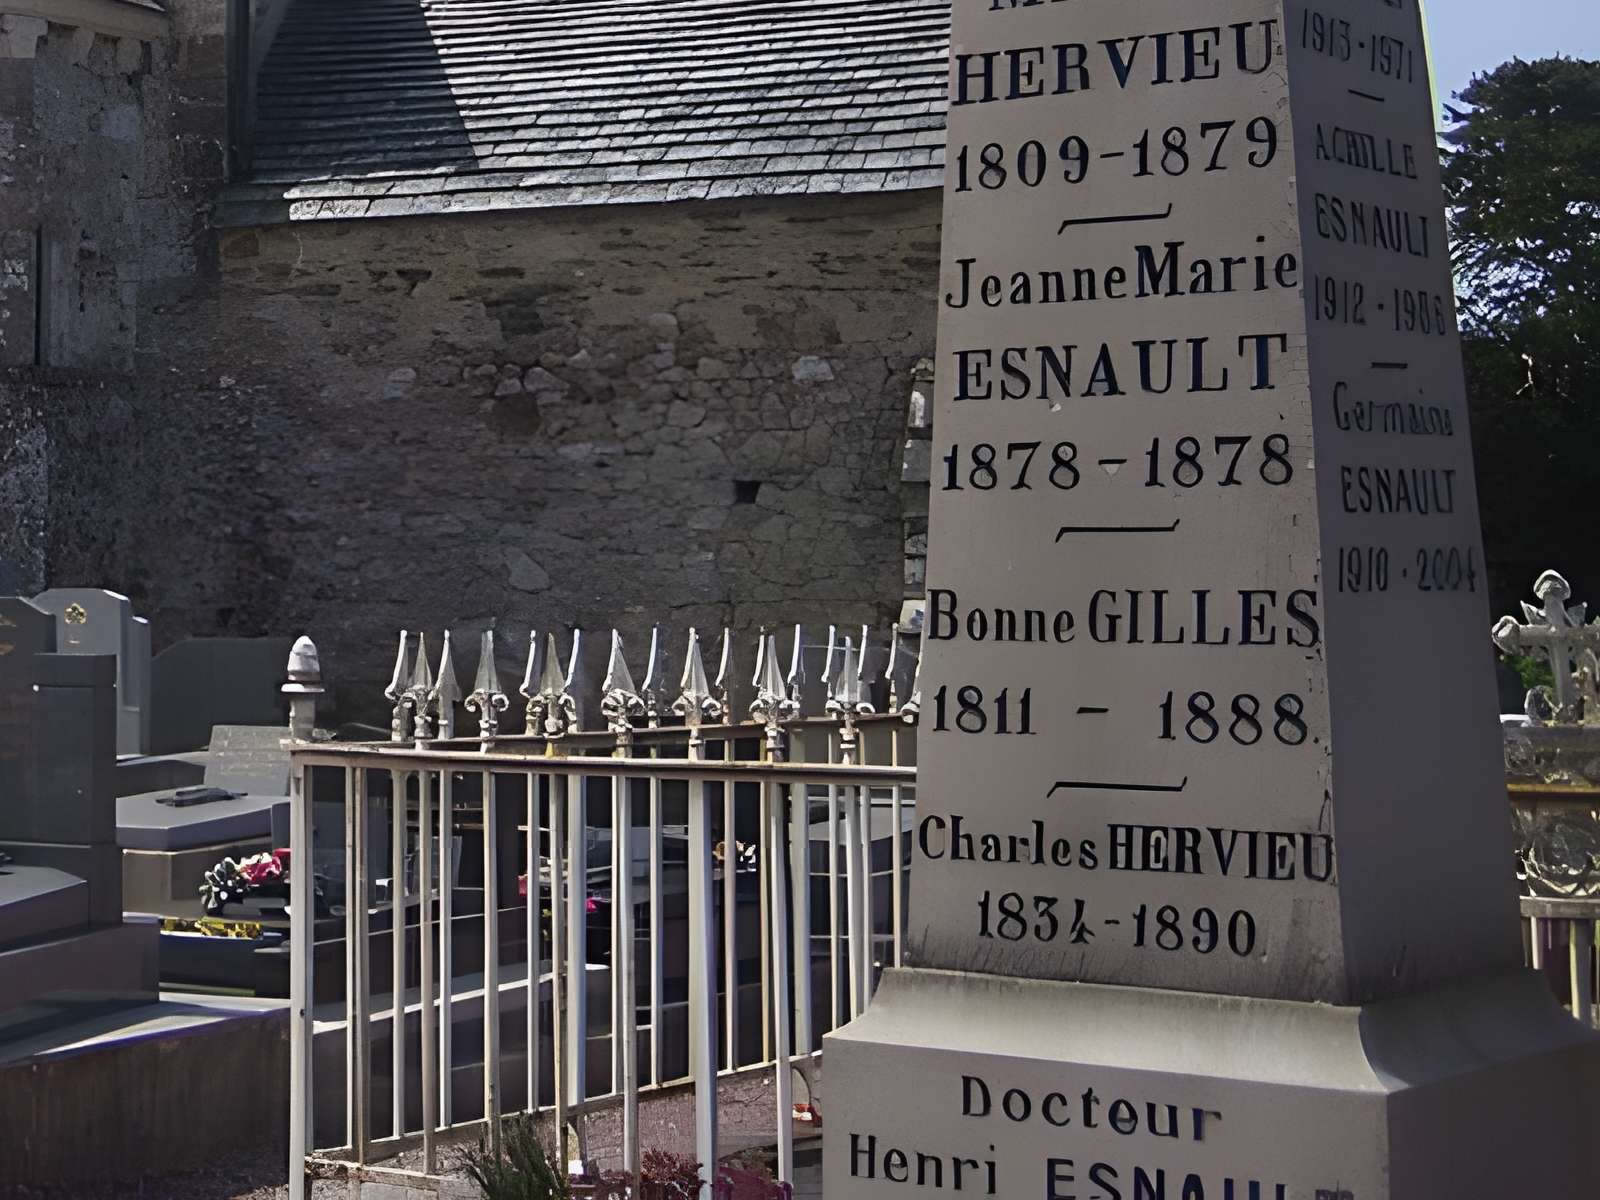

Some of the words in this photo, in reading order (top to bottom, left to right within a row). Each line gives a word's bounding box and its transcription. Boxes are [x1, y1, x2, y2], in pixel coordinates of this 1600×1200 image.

[952, 19, 1279, 107] HERVIEU
[955, 116, 1278, 192] 1809-1879
[1314, 192, 1429, 259] ESNAULT
[952, 333, 1288, 401] ESNAULT
[1340, 464, 1456, 515] ESNAULT
[927, 588, 1075, 642] Bonne
[1088, 589, 1324, 649] GILLES
[932, 685, 1037, 736] 1811
[918, 814, 1099, 870] Charles
[1107, 822, 1337, 886] HERVIEU
[977, 890, 1256, 957] 1834-1890
[961, 1075, 1223, 1142] Docteur
[849, 1132, 997, 1195] Henri
